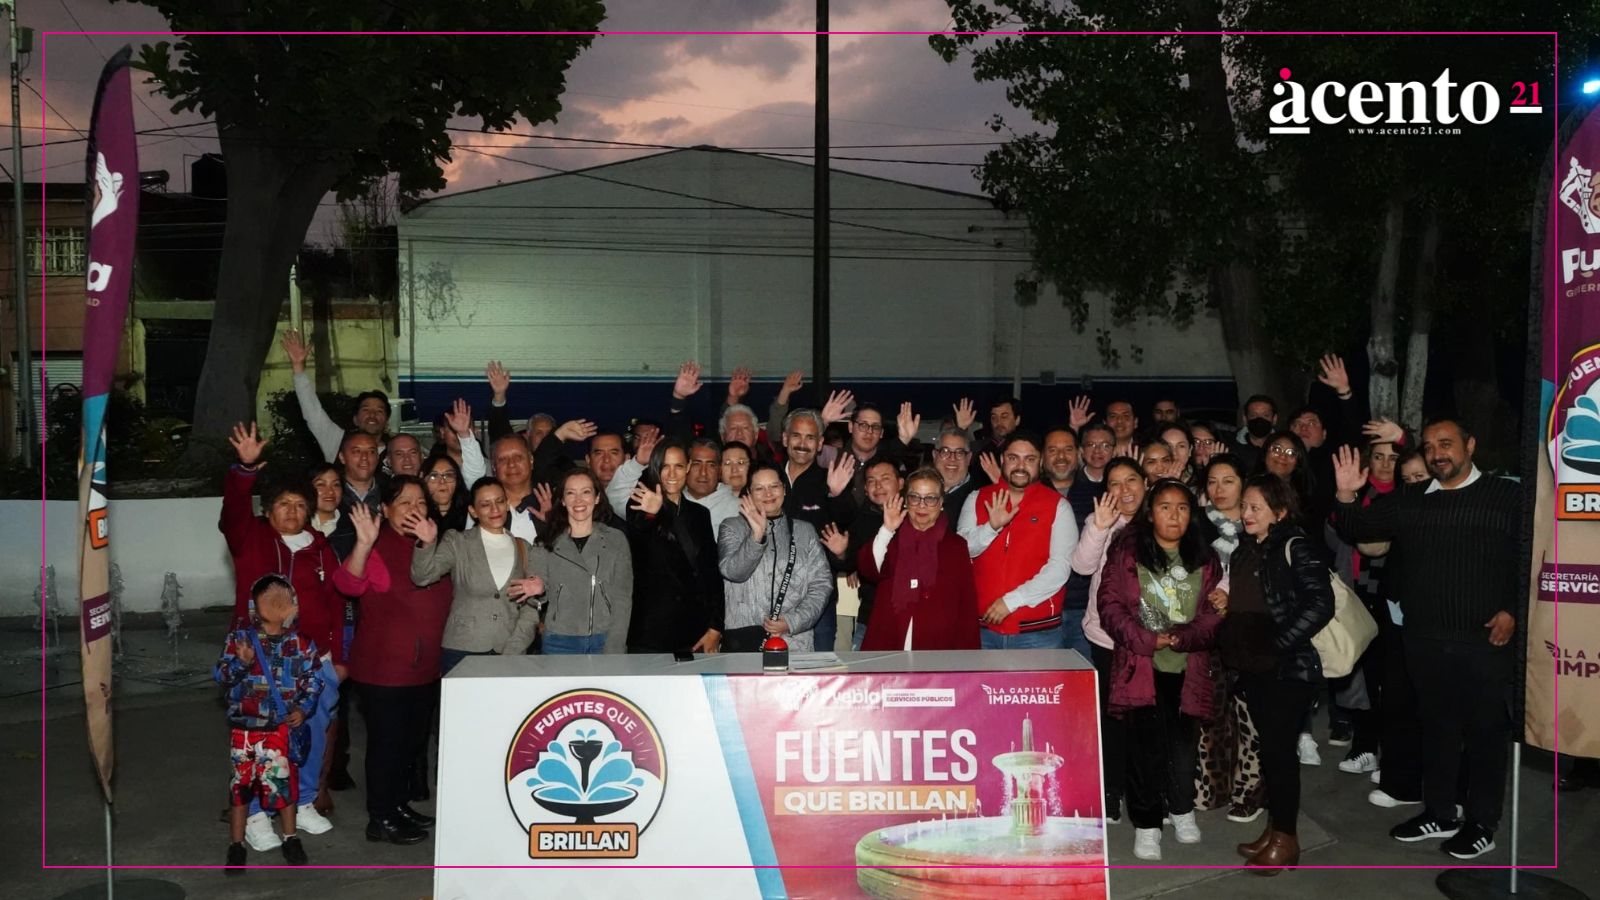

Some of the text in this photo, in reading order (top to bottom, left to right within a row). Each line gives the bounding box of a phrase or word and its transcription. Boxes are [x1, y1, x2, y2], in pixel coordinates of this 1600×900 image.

[780, 572, 791, 594] KIPLING
[1564, 648, 1586, 660] LA
[988, 694, 1061, 705] IMPARABLE
[534, 701, 638, 736] FUENTES QUE
[775, 729, 978, 783] FUENTES
[783, 790, 967, 813] QUE BRILLAN
[538, 831, 630, 851] BRILLAN
